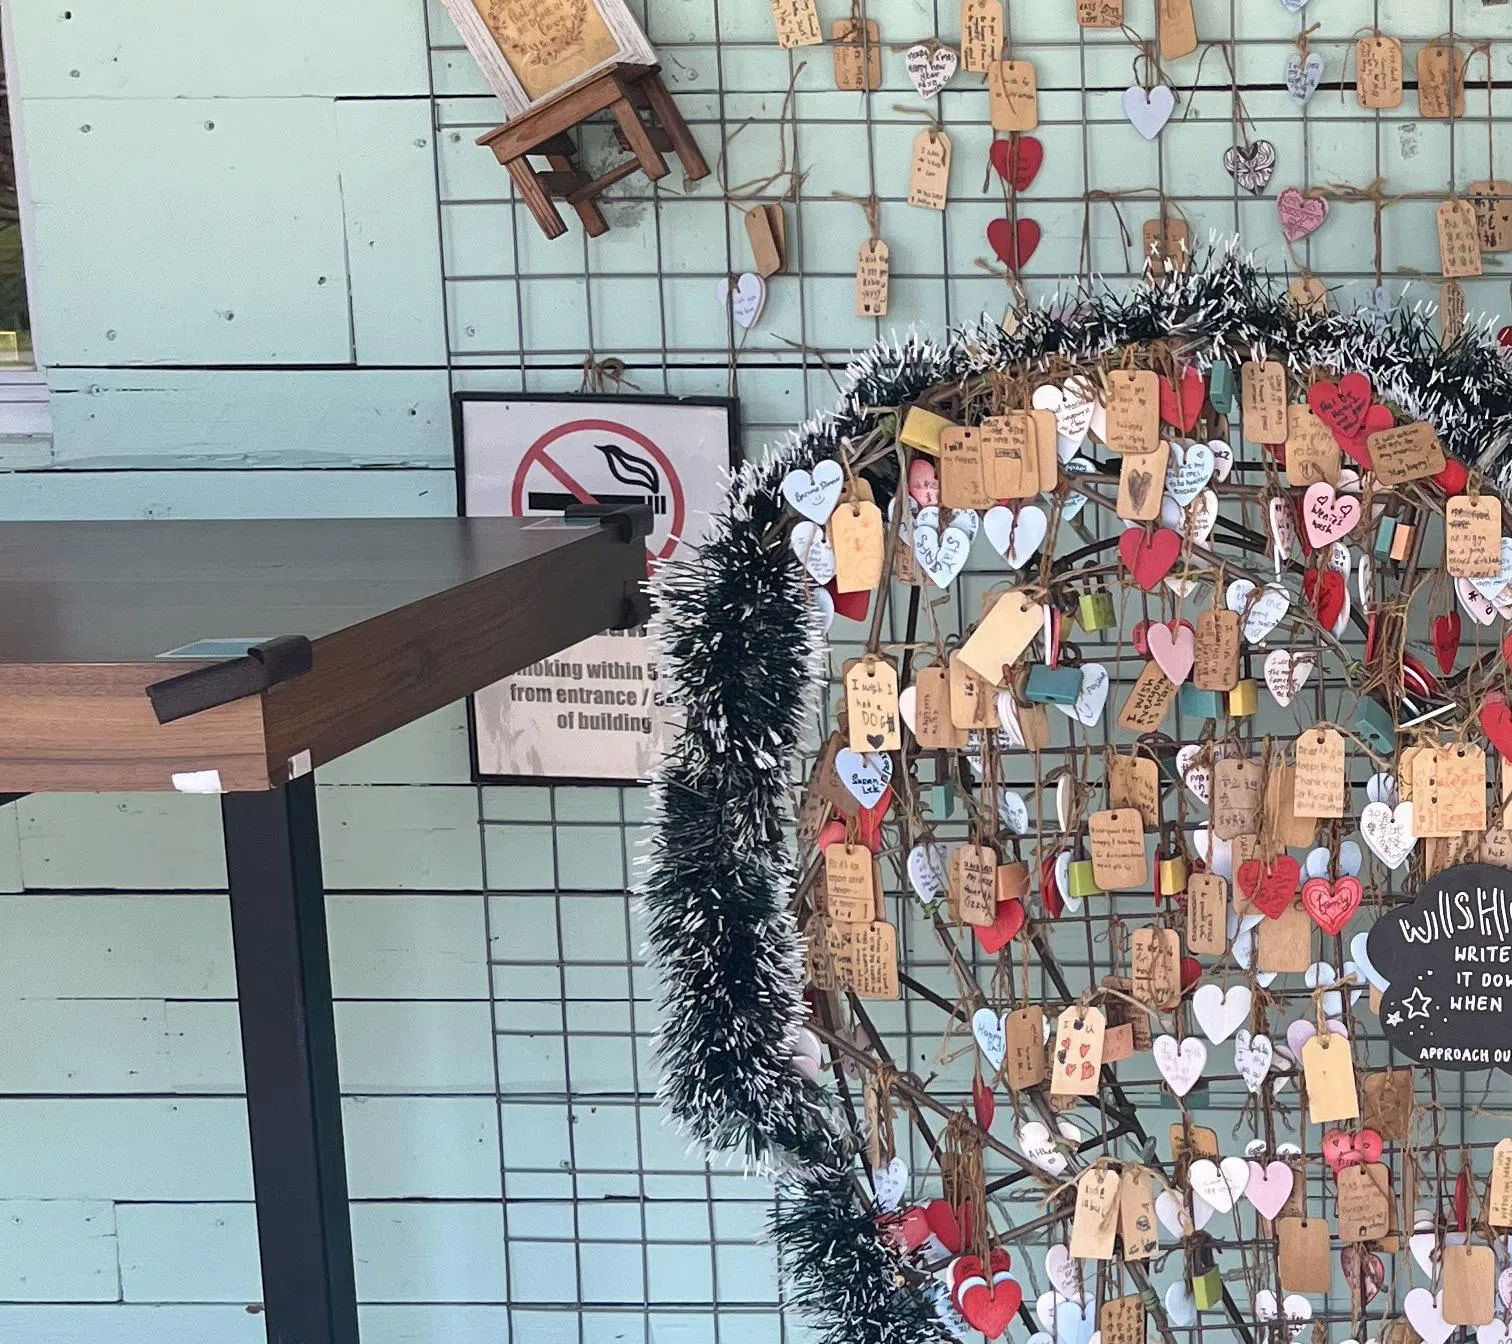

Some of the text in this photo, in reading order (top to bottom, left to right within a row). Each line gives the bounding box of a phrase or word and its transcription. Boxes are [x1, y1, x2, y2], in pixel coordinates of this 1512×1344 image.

[516, 658, 583, 680] moking
[586, 661, 643, 680] within
[510, 684, 554, 702] from
[557, 686, 637, 706] entrance
[852, 679, 859, 691] I
[862, 683, 883, 695] wish
[557, 712, 652, 734] of building
[1454, 945, 1512, 963] WRITE
[1456, 972, 1472, 987] IT
[1449, 995, 1502, 1012] WHEN
[1419, 1046, 1490, 1063] APPROACH
